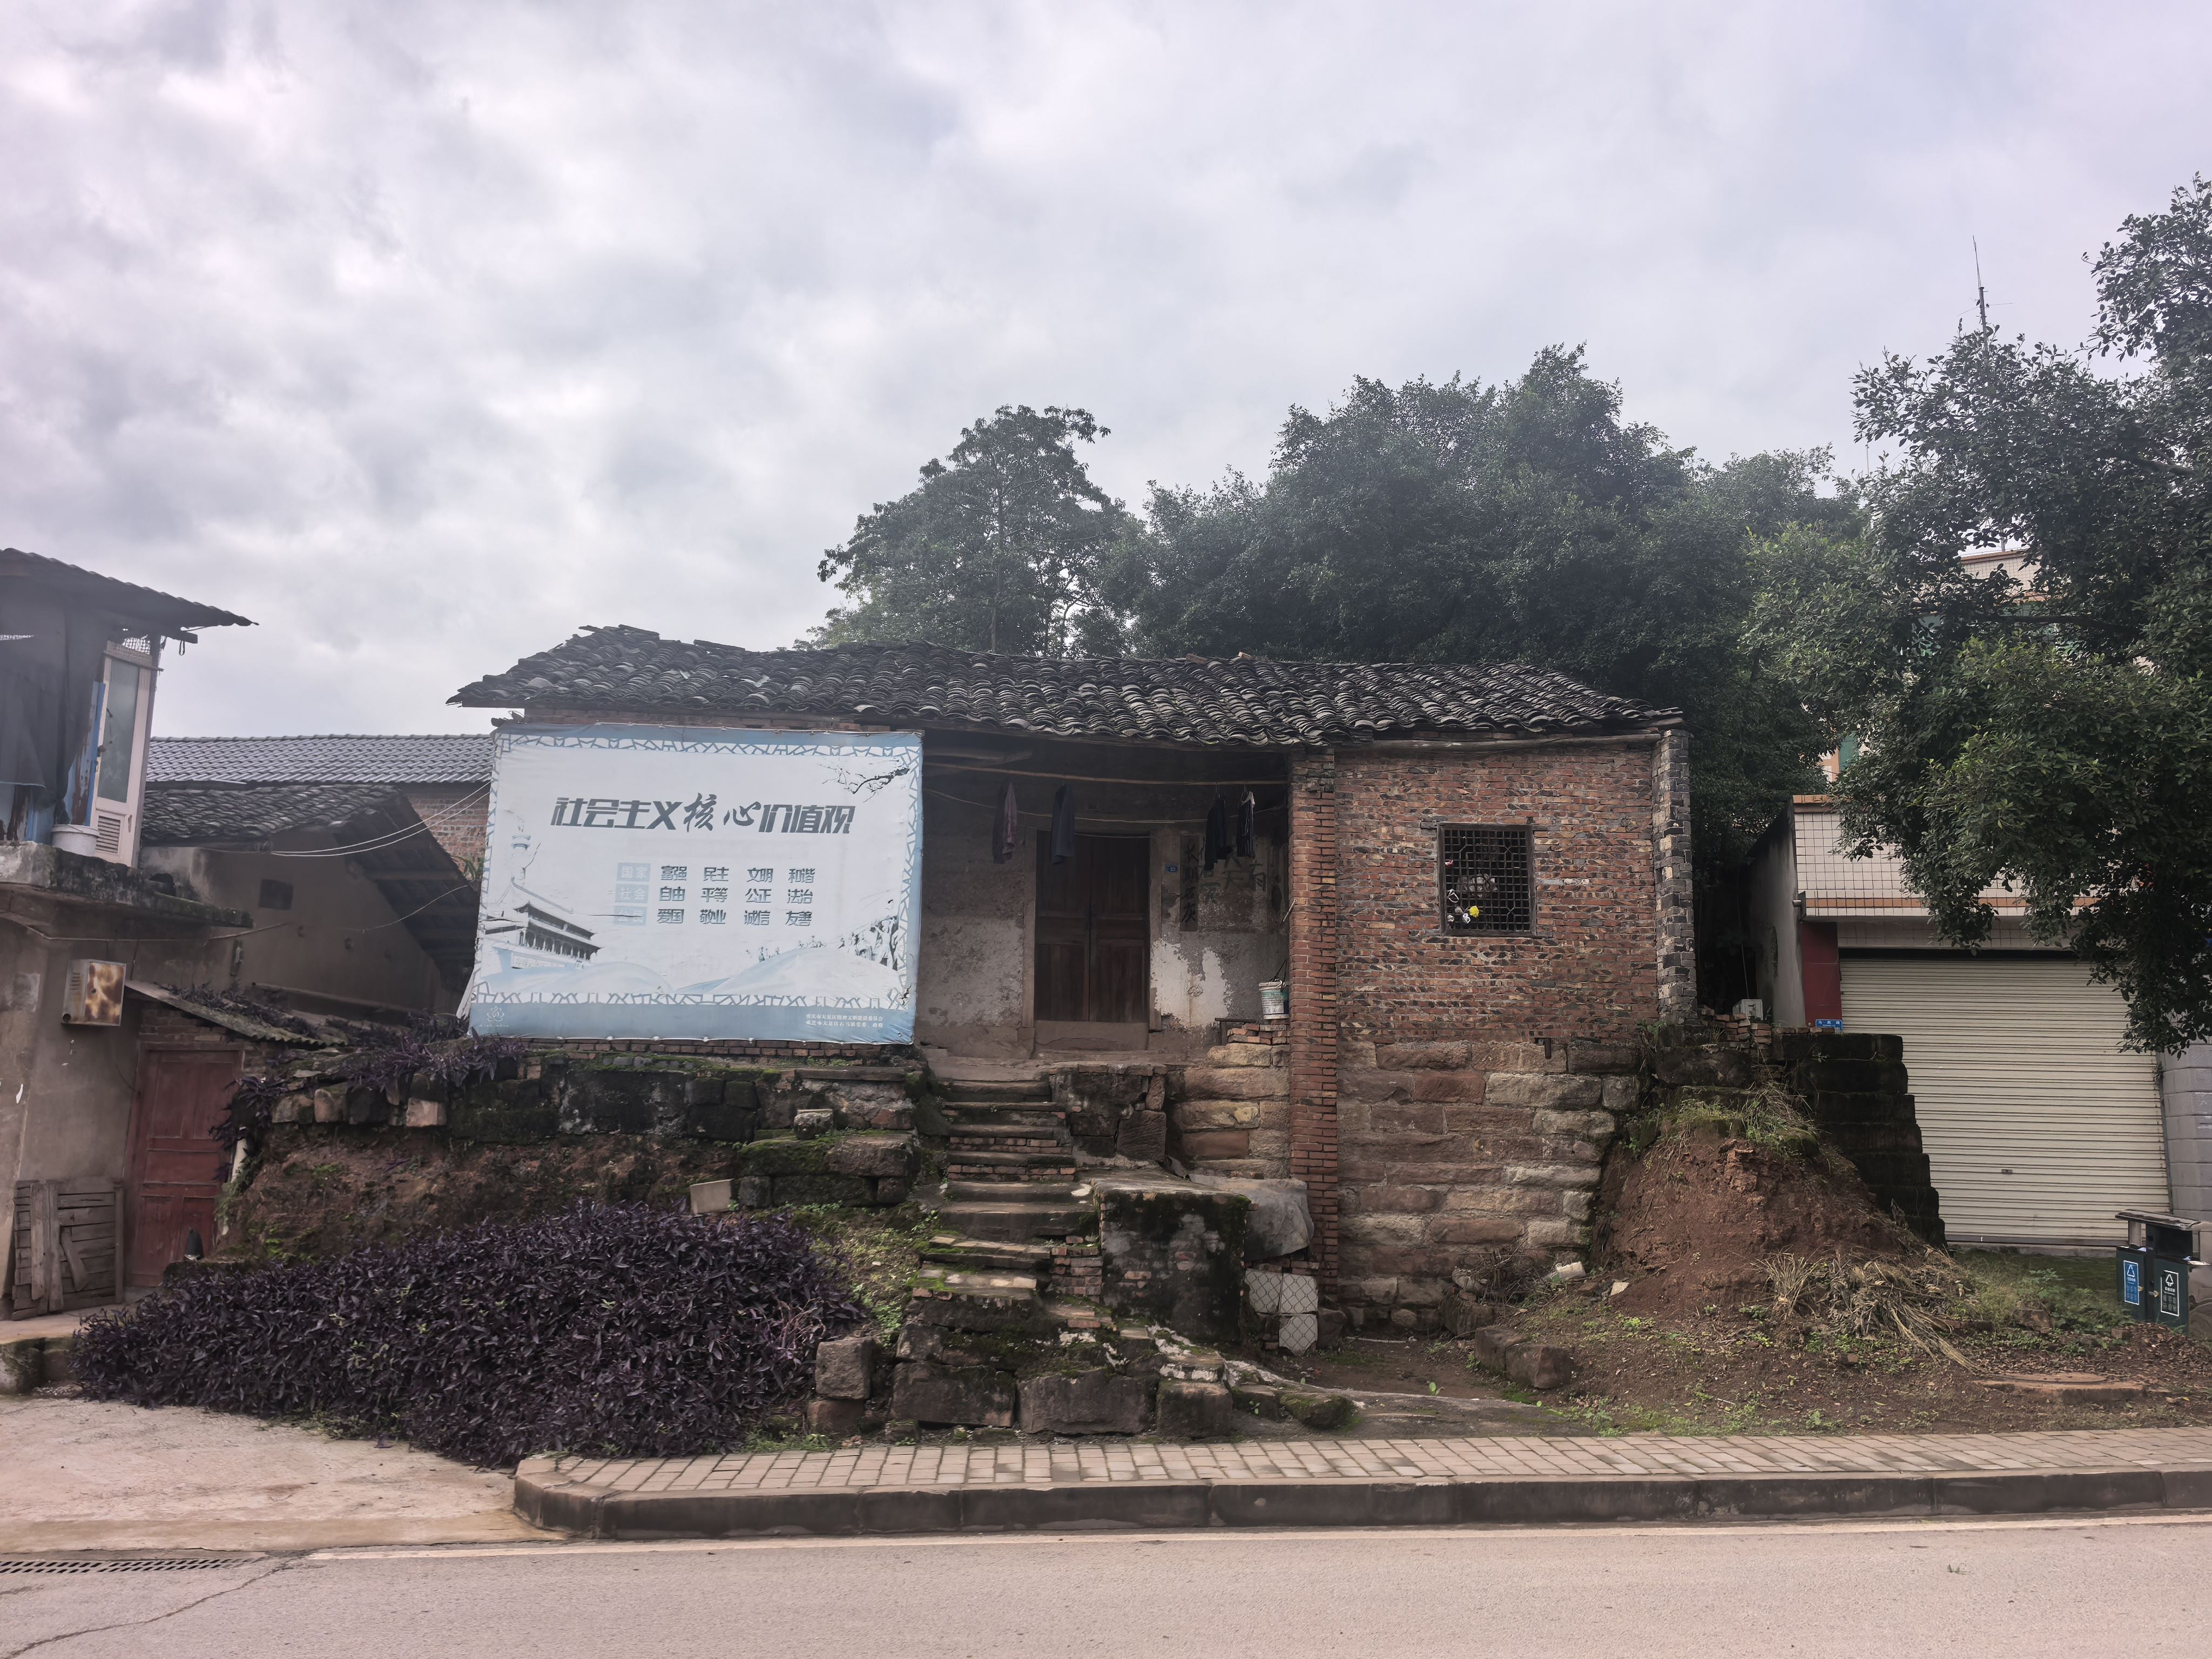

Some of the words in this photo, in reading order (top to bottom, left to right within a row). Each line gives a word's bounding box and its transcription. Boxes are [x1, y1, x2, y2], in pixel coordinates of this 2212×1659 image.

[550, 792, 856, 834] 社会主义核心价值观
[621, 866, 649, 879] 国家
[660, 865, 687, 881] 富强
[703, 867, 729, 882] 民主
[746, 867, 773, 883] 文明
[788, 868, 815, 883] 和谐
[619, 887, 645, 900] 社会
[658, 886, 685, 901] 自由
[700, 887, 729, 902] 平等
[745, 888, 772, 903] 公正
[787, 889, 813, 903] 法治
[656, 908, 684, 923] 爱国
[699, 909, 726, 925] 敬业
[743, 910, 771, 925] 诚信
[785, 911, 813, 926] 友善
